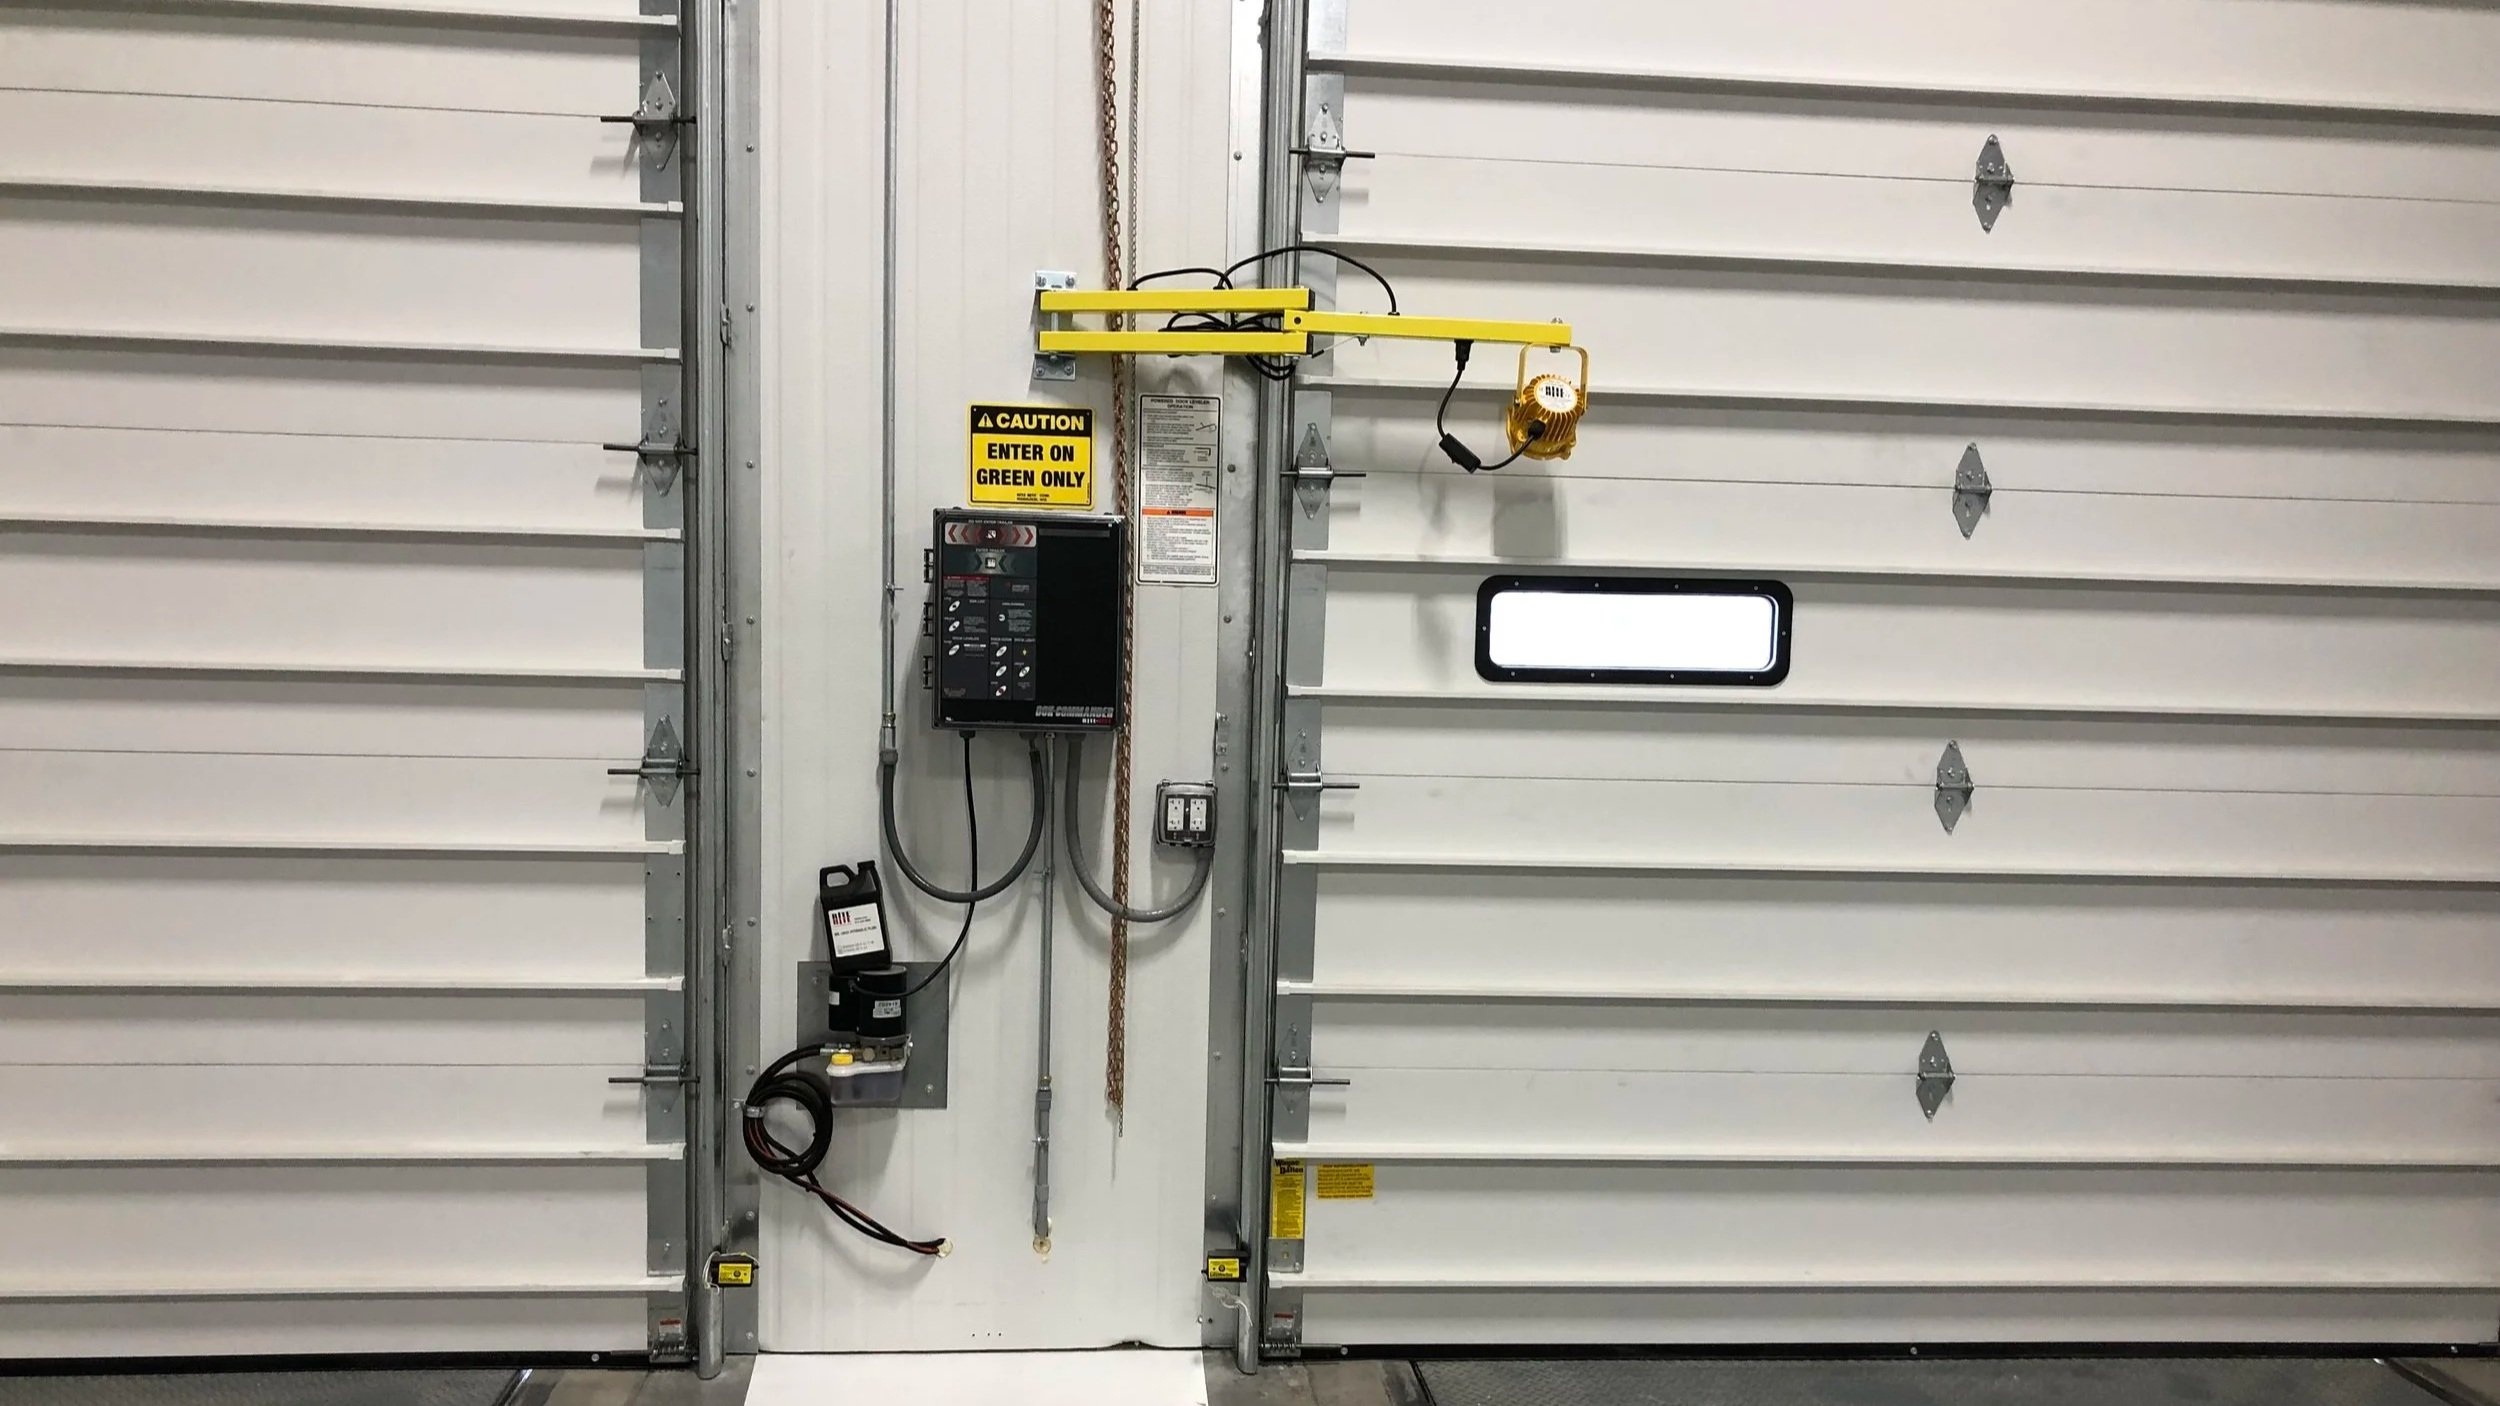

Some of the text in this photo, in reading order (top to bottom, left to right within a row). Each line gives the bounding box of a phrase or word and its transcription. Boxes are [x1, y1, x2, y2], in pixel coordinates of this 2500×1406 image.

[996, 412, 1085, 431] CAUTION
[987, 443, 1075, 462] ENTER ON
[976, 468, 1086, 488] GREEN ONLY
[1274, 1159, 1300, 1168] Wayne
[1279, 1166, 1304, 1175] Dalton
